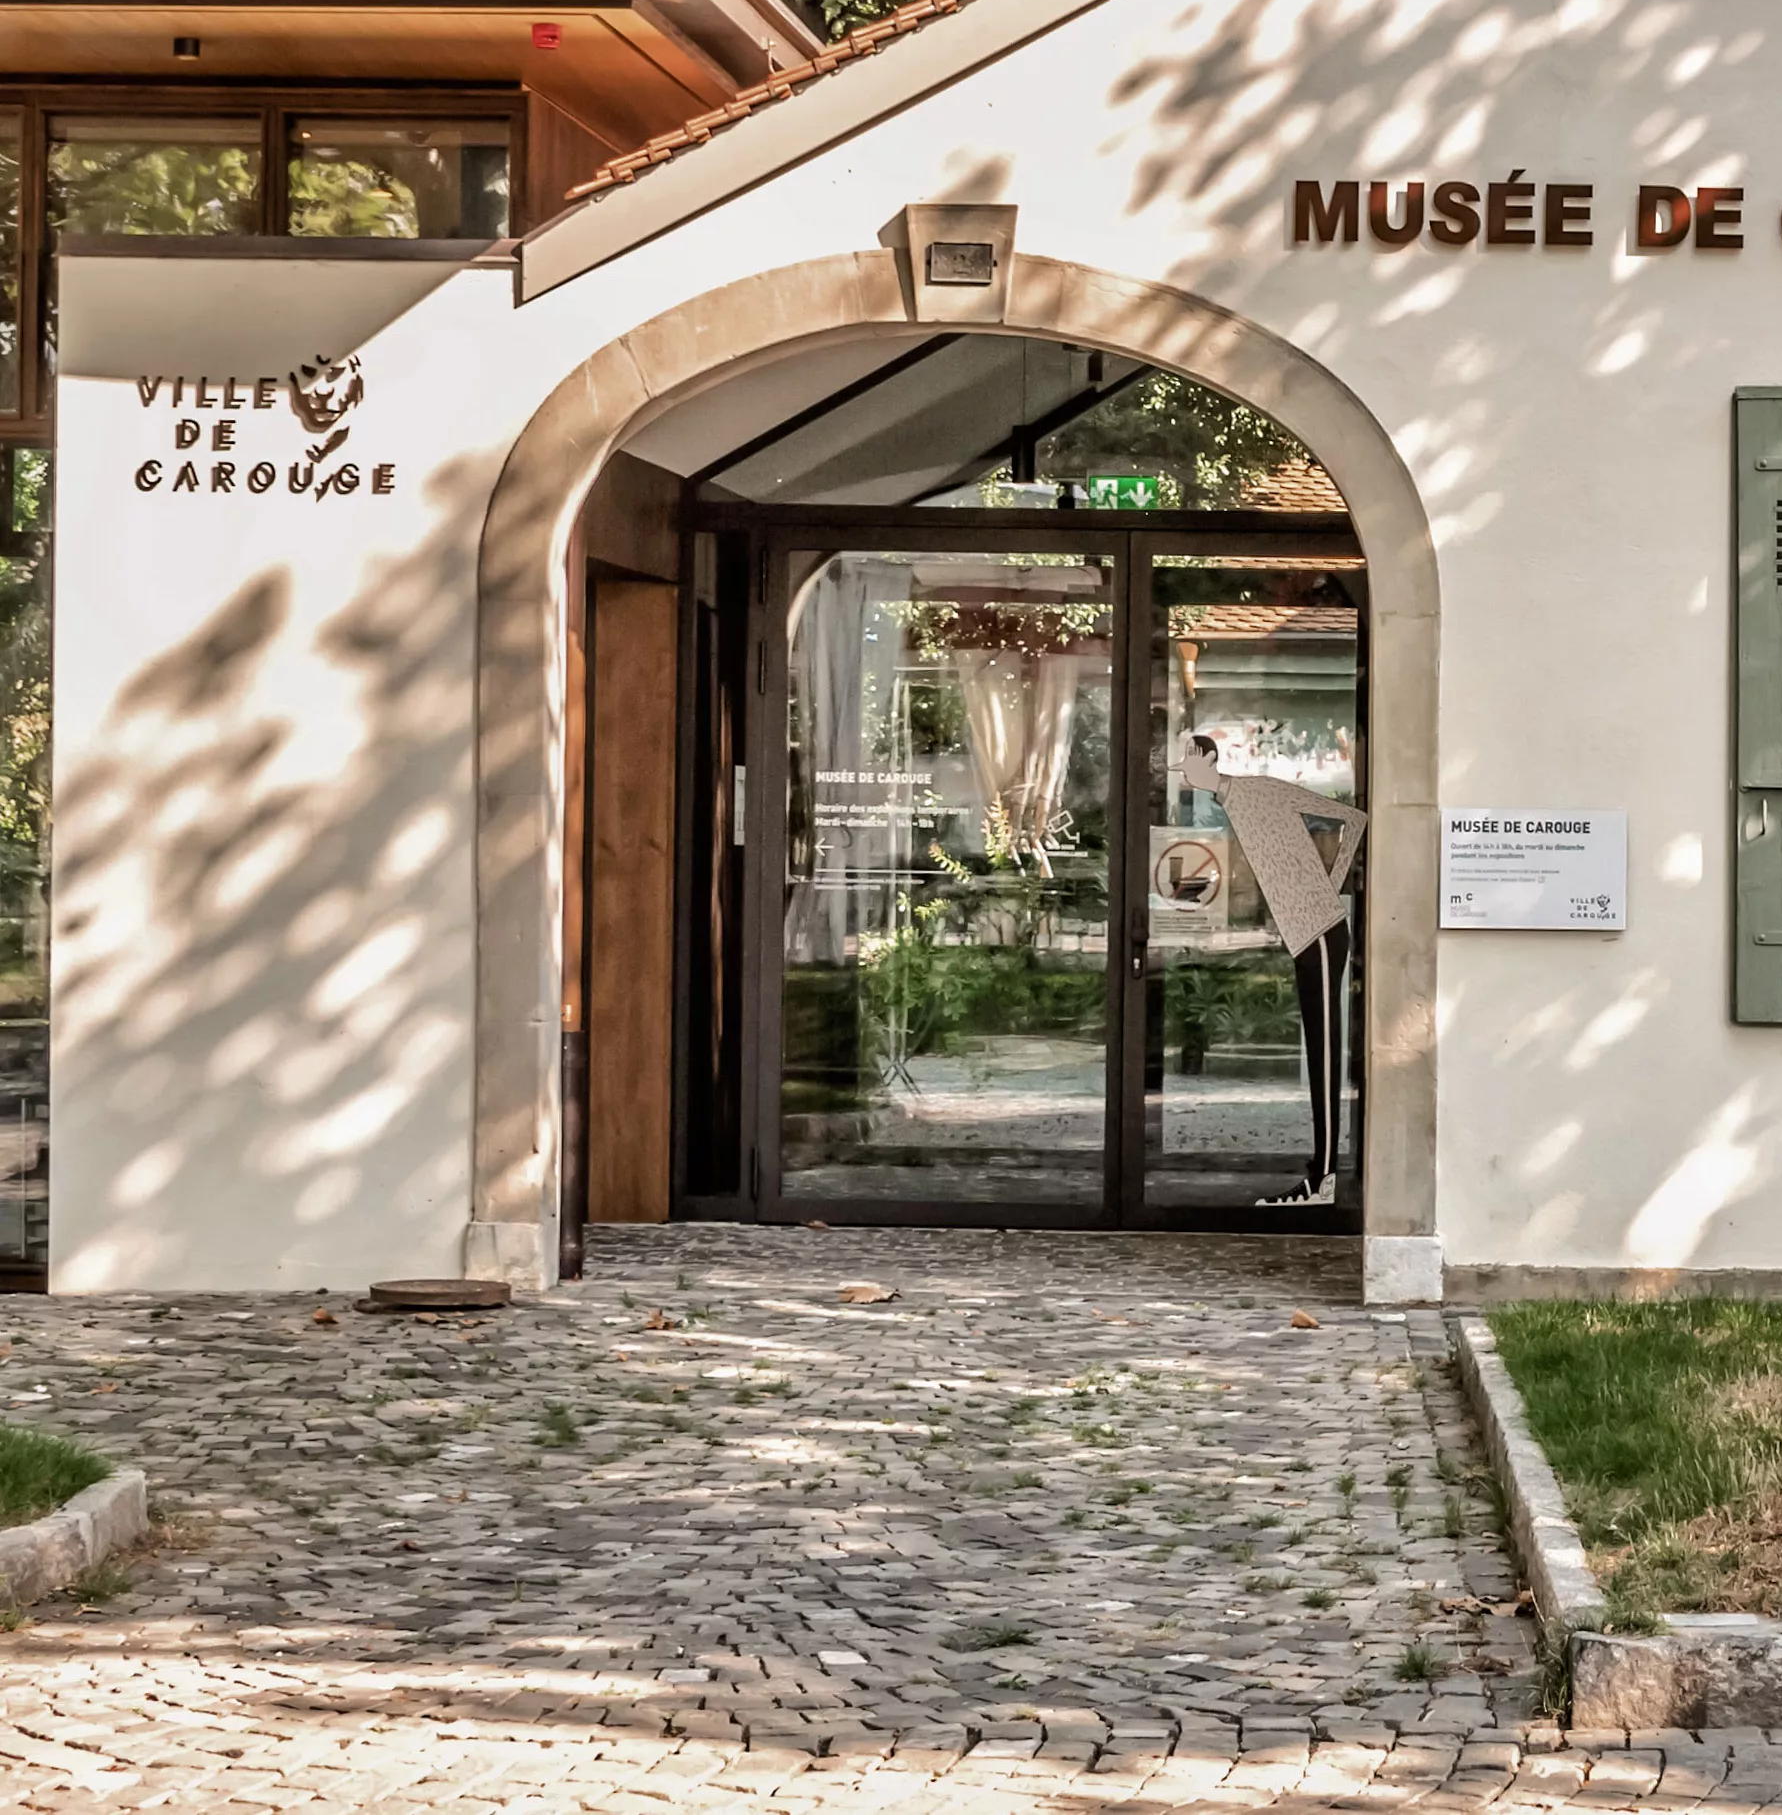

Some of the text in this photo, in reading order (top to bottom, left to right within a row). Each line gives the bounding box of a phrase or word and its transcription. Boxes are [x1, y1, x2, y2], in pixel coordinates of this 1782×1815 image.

[1294, 169, 1594, 245] MUSÉE
[1638, 185, 1744, 249] DE
[140, 375, 278, 406] VILLE
[178, 418, 236, 448] DE
[137, 459, 396, 492] CAROUGE
[815, 769, 932, 785] MUSÉE DE CAROUGE
[1451, 817, 1591, 834] MUSÉE DE CAROUGE
[1450, 894, 1462, 904] m
[1569, 912, 1617, 920] CAROUGE
